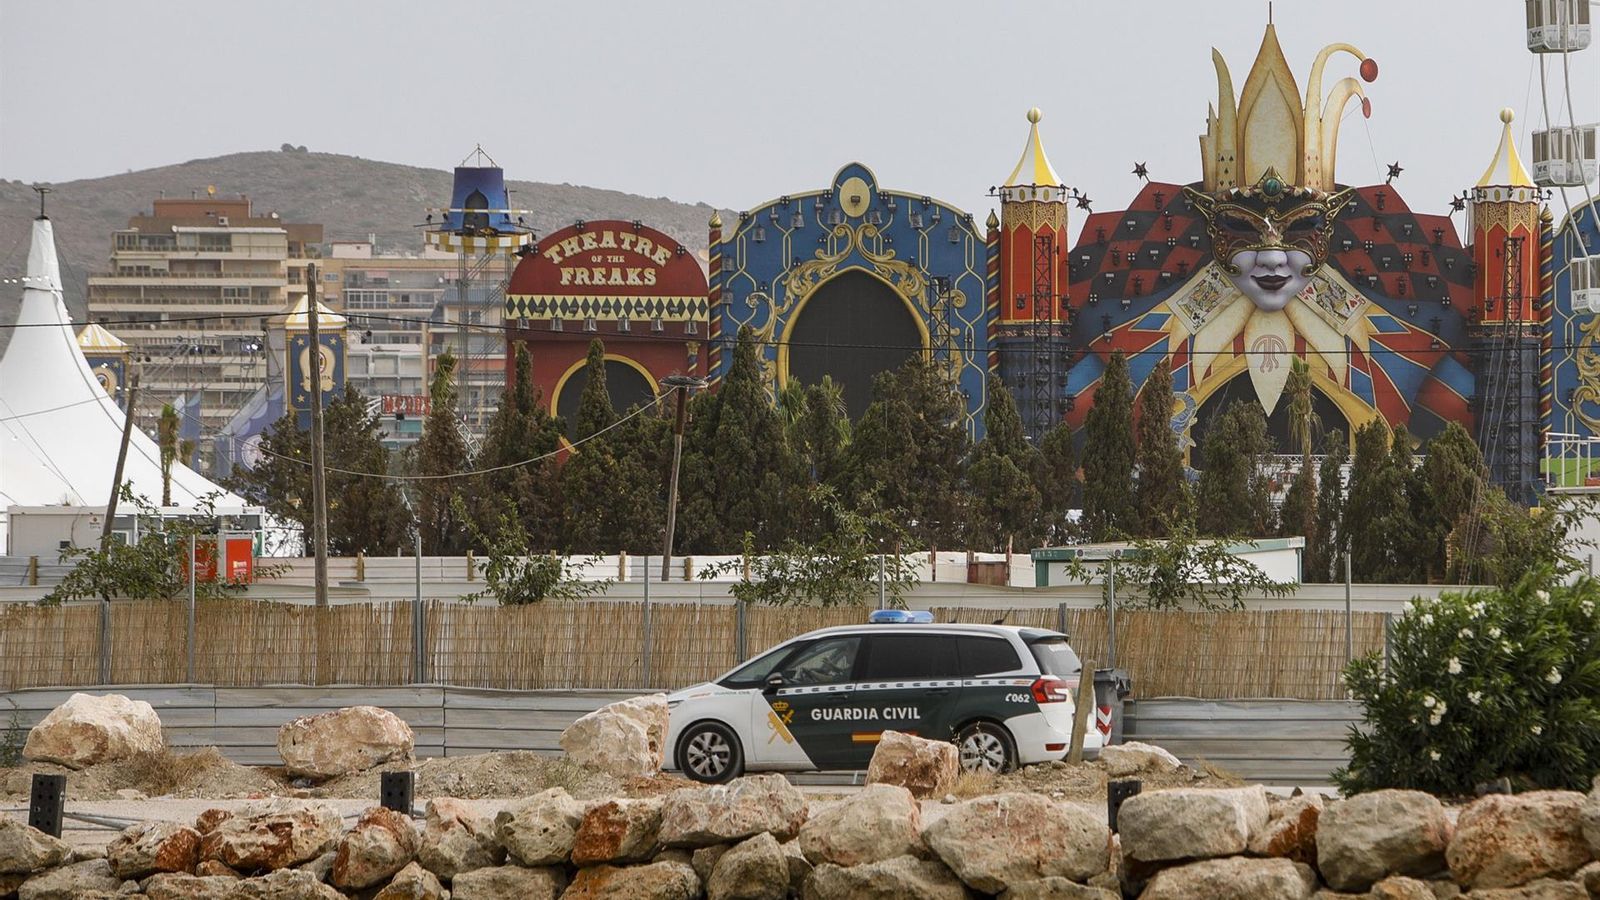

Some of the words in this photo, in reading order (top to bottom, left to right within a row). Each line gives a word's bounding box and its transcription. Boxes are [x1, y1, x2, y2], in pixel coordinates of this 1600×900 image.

[544, 230, 672, 267] THEATRE
[591, 255, 602, 263] OF
[607, 255, 625, 263] THE
[560, 267, 657, 286] FREAKS
[811, 708, 879, 720] GUARDIA
[883, 707, 921, 720] CIVIL
